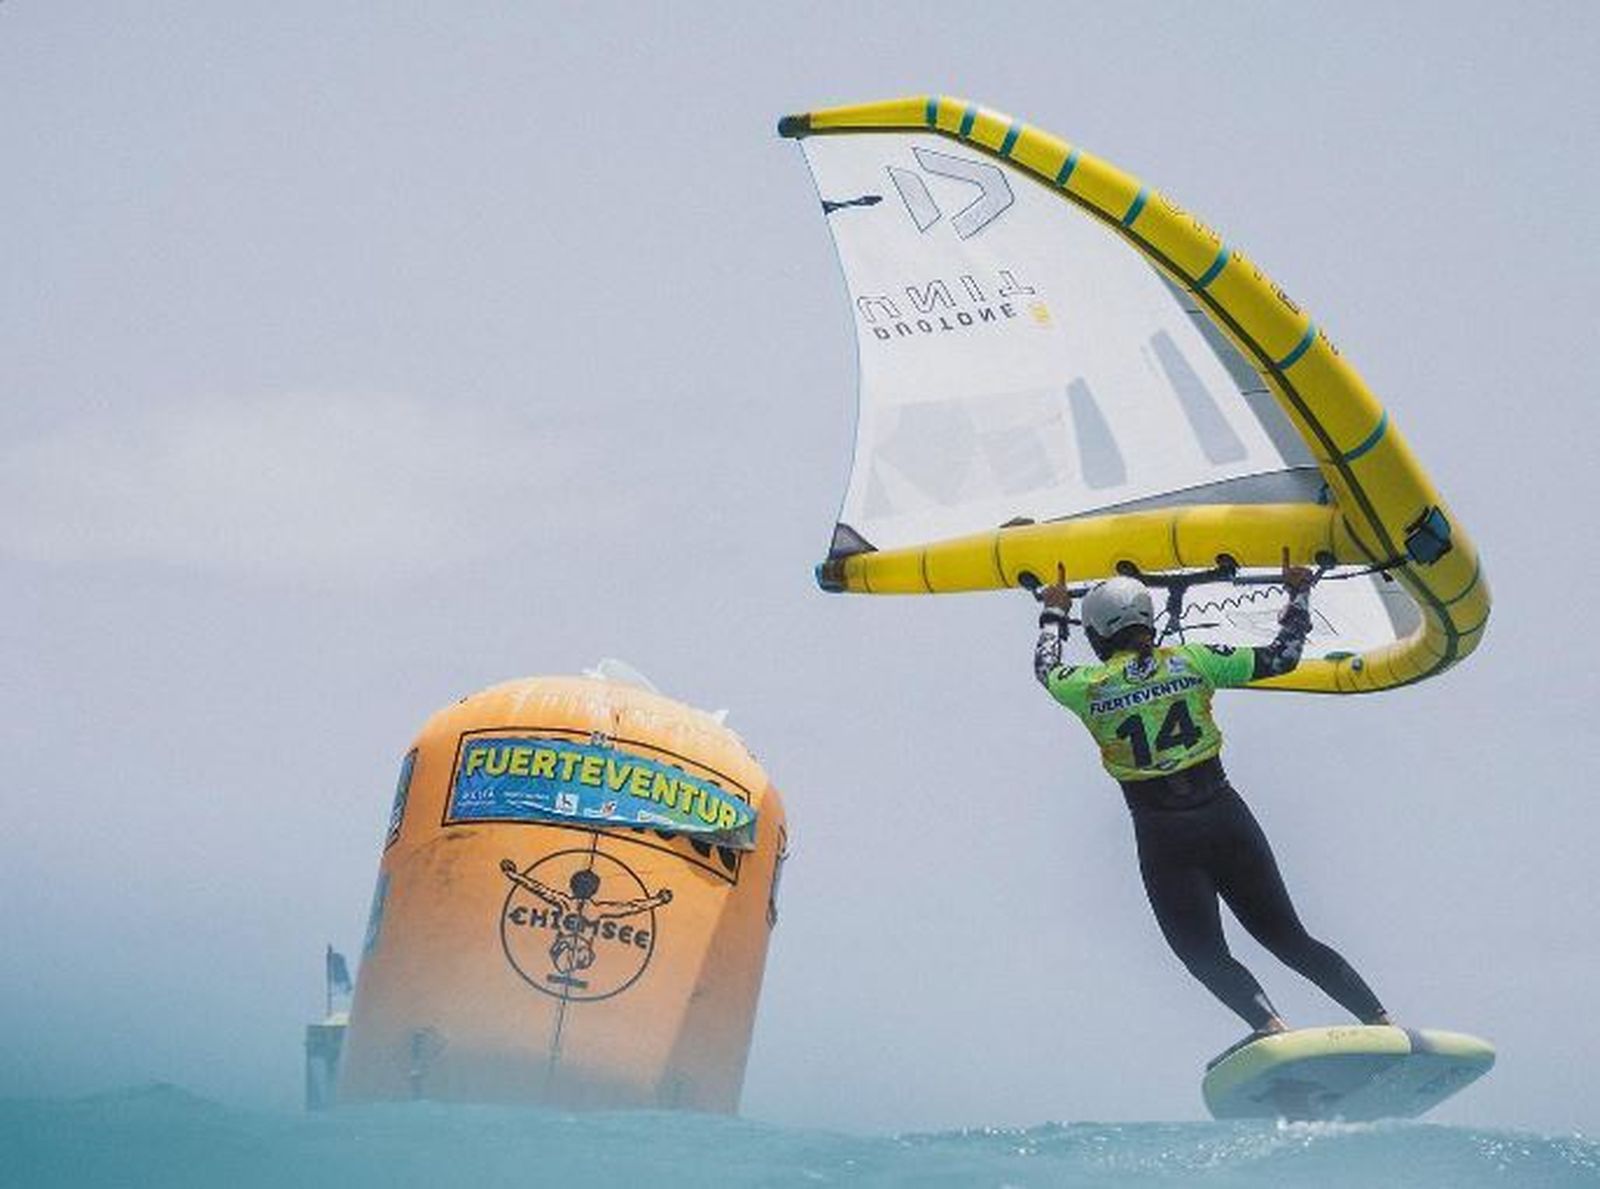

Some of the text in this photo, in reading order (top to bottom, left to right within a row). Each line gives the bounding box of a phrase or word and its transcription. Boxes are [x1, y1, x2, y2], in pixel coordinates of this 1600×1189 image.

[1115, 699, 1203, 767] 14
[465, 747, 750, 831] FUERTEVENTUR
[508, 905, 651, 949] CHIEMSEE
